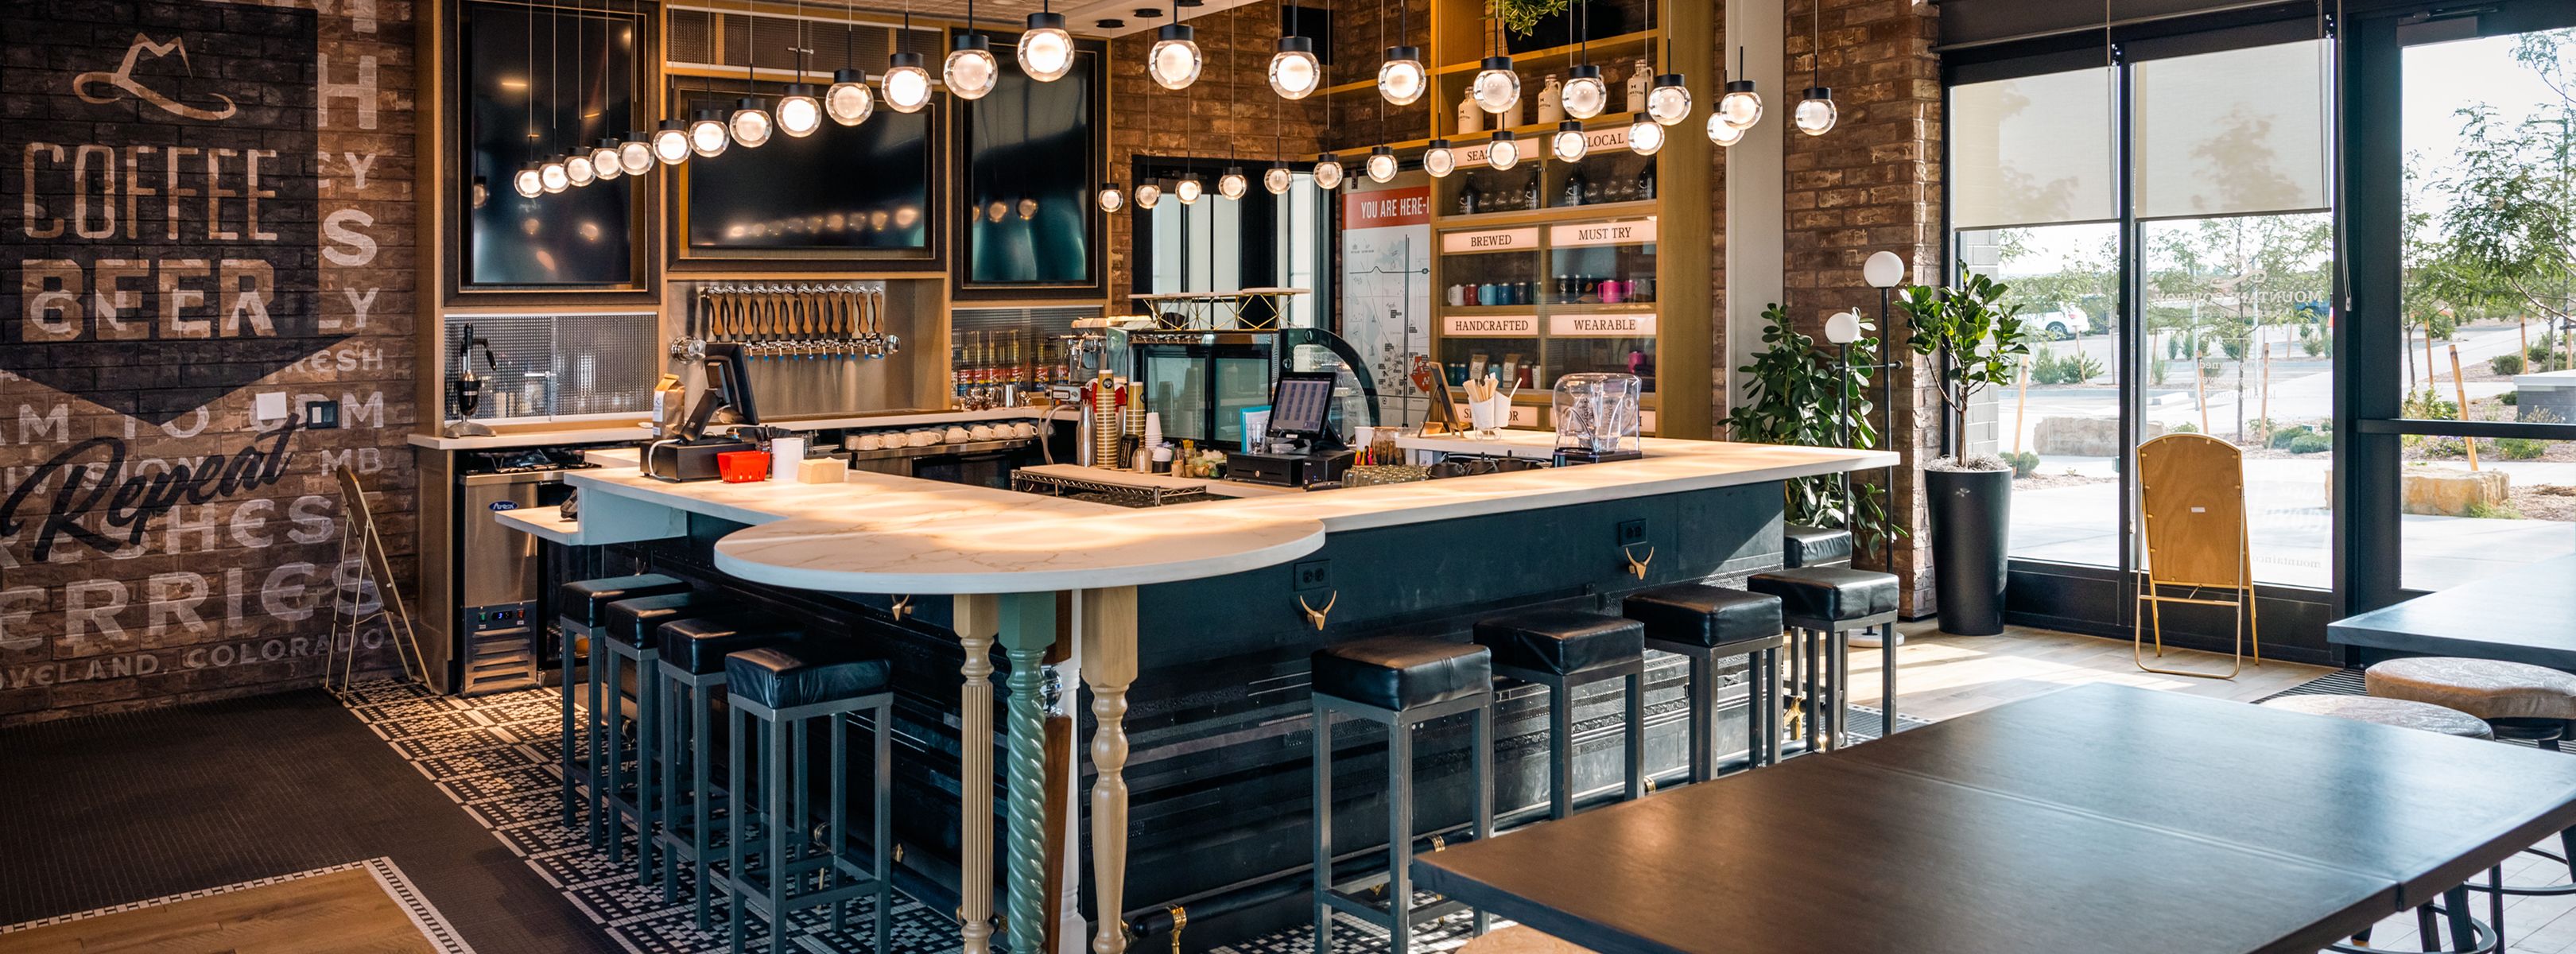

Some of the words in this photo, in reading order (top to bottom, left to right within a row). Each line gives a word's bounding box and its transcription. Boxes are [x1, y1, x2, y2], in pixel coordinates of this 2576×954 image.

[1588, 133, 1624, 147] LOCAL
[24, 142, 277, 240] COFFEE
[1361, 201, 1378, 219] YOU
[1380, 199, 1398, 218] ARE
[1471, 234, 1512, 247] BREWED
[1578, 228, 1608, 241] MUST
[1612, 227, 1632, 238] TRY
[22, 258, 277, 342] BEER
[1456, 320, 1529, 332] HANDCRAFTED
[1574, 319, 1636, 331] WEARABLE
[0, 413, 312, 561] Repeat
[0, 653, 169, 691] VELAND,
[182, 628, 385, 670] COLORADO
